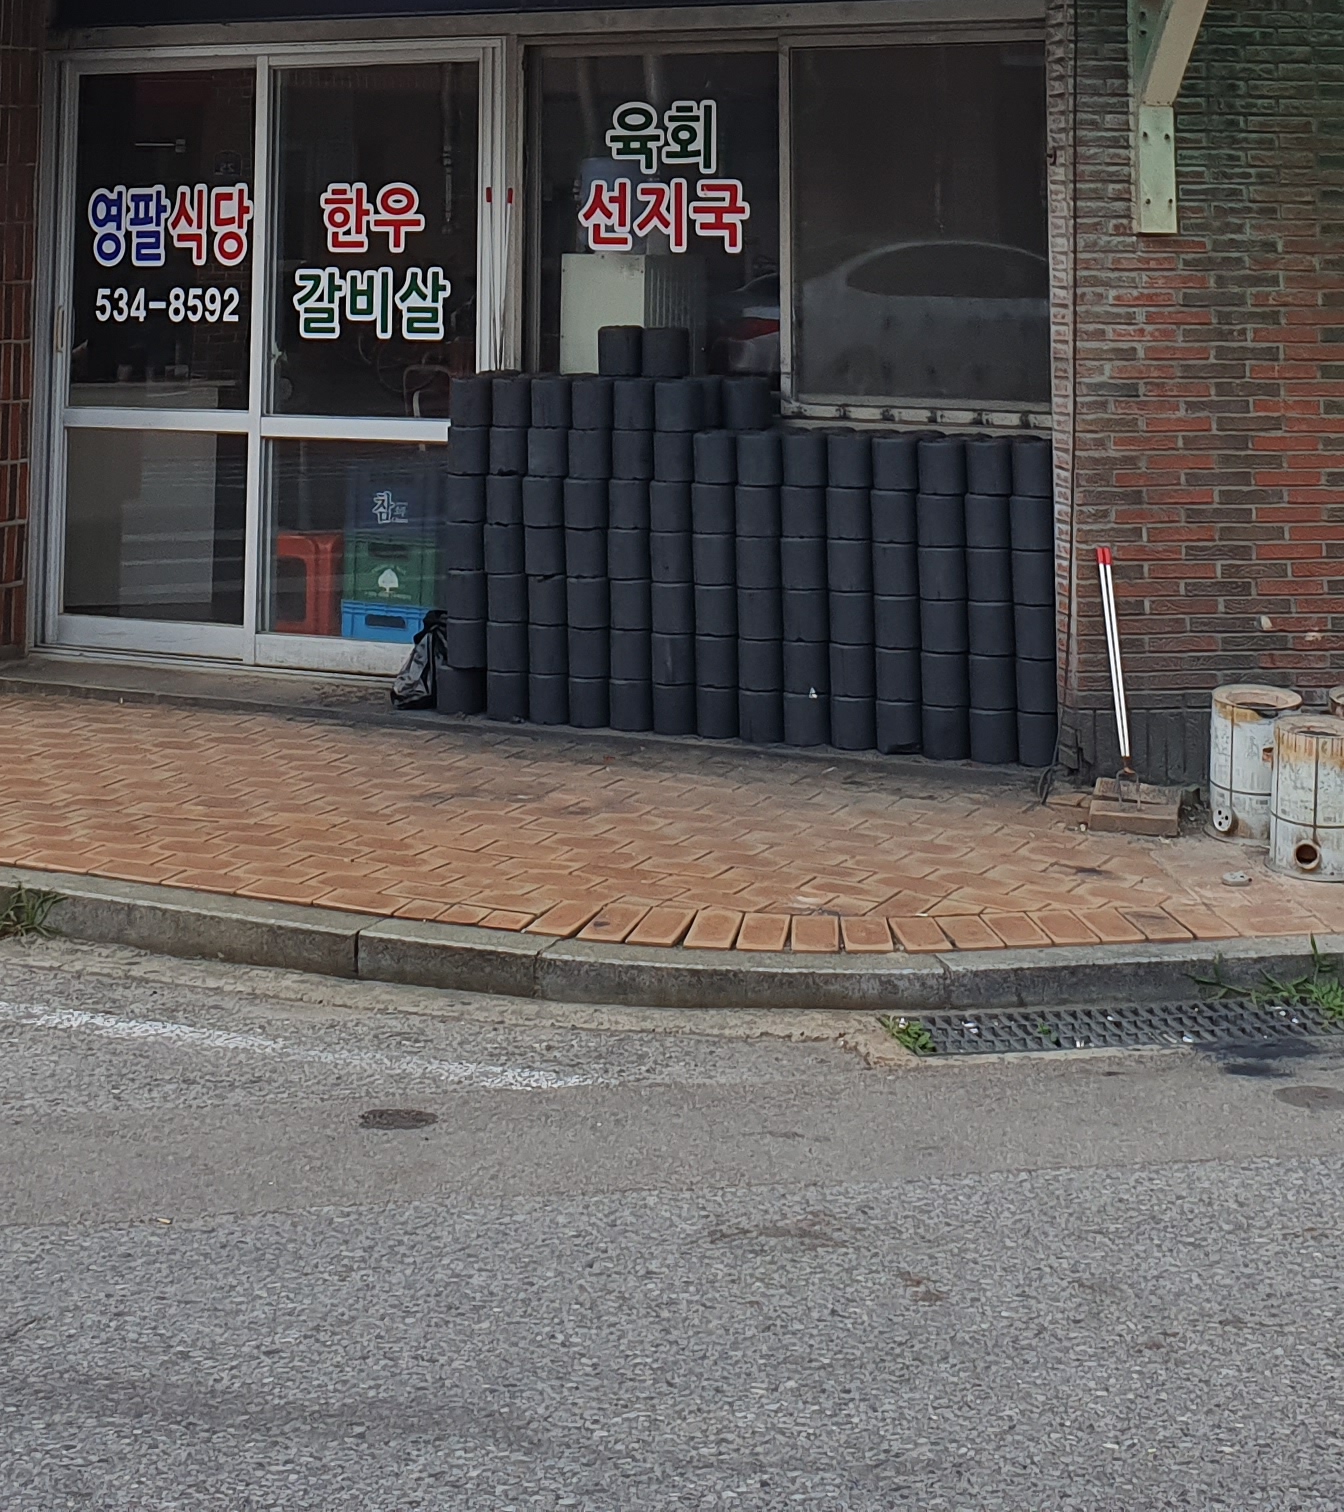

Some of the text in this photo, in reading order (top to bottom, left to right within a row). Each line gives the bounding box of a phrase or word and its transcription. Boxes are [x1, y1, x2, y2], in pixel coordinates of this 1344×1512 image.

[605, 99, 717, 175] 육회
[88, 182, 254, 267] 영팔식당
[320, 181, 426, 254] 한우
[578, 177, 750, 254] 선지국
[95, 286, 240, 323] 534-8592
[293, 266, 451, 341] 갈비살
